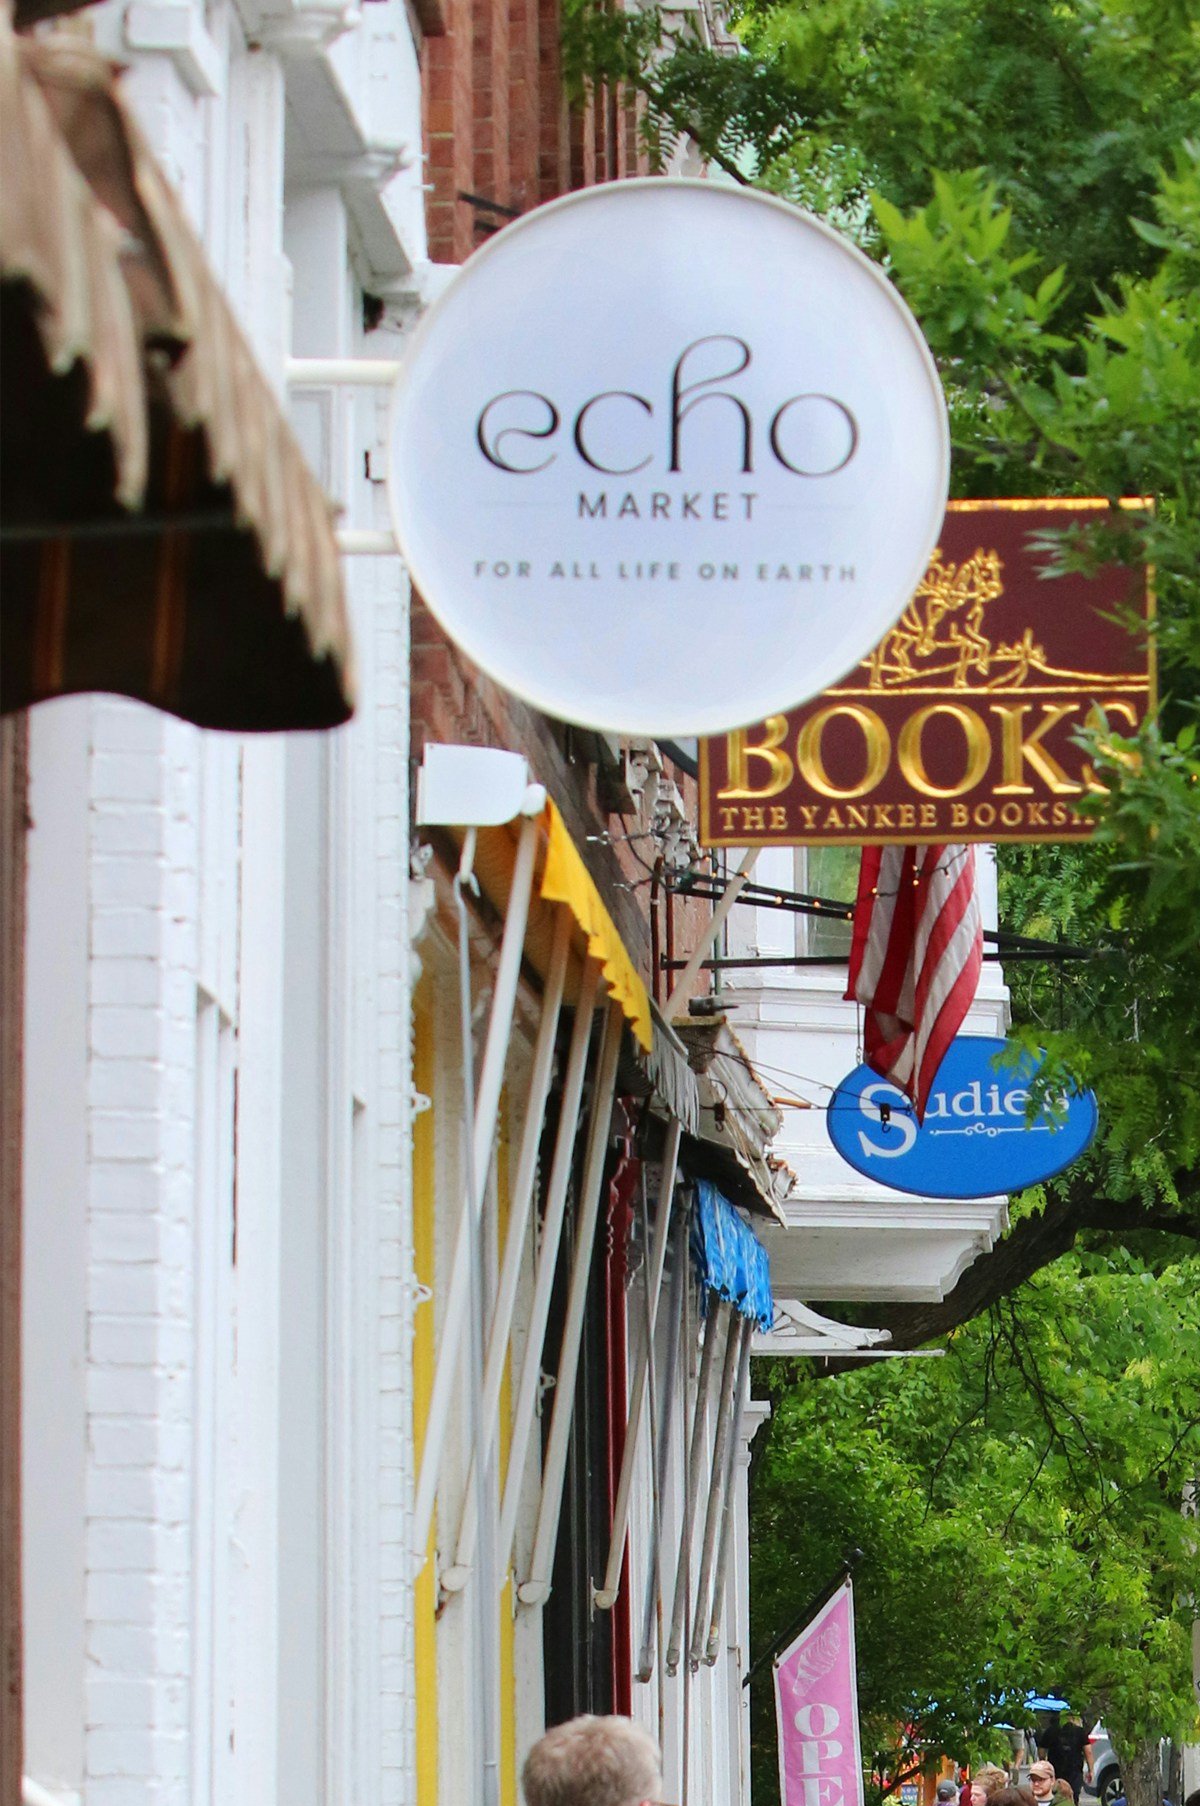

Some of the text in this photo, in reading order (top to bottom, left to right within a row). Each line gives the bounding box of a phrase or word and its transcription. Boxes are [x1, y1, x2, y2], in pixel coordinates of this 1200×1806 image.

[473, 334, 859, 478] echo
[576, 491, 757, 522] MARKET
[473, 560, 857, 583] FOR ALL LIFE ON EARTH
[717, 701, 1143, 799] BOOKS
[720, 805, 788, 831] THE
[800, 803, 938, 830] YANKEE
